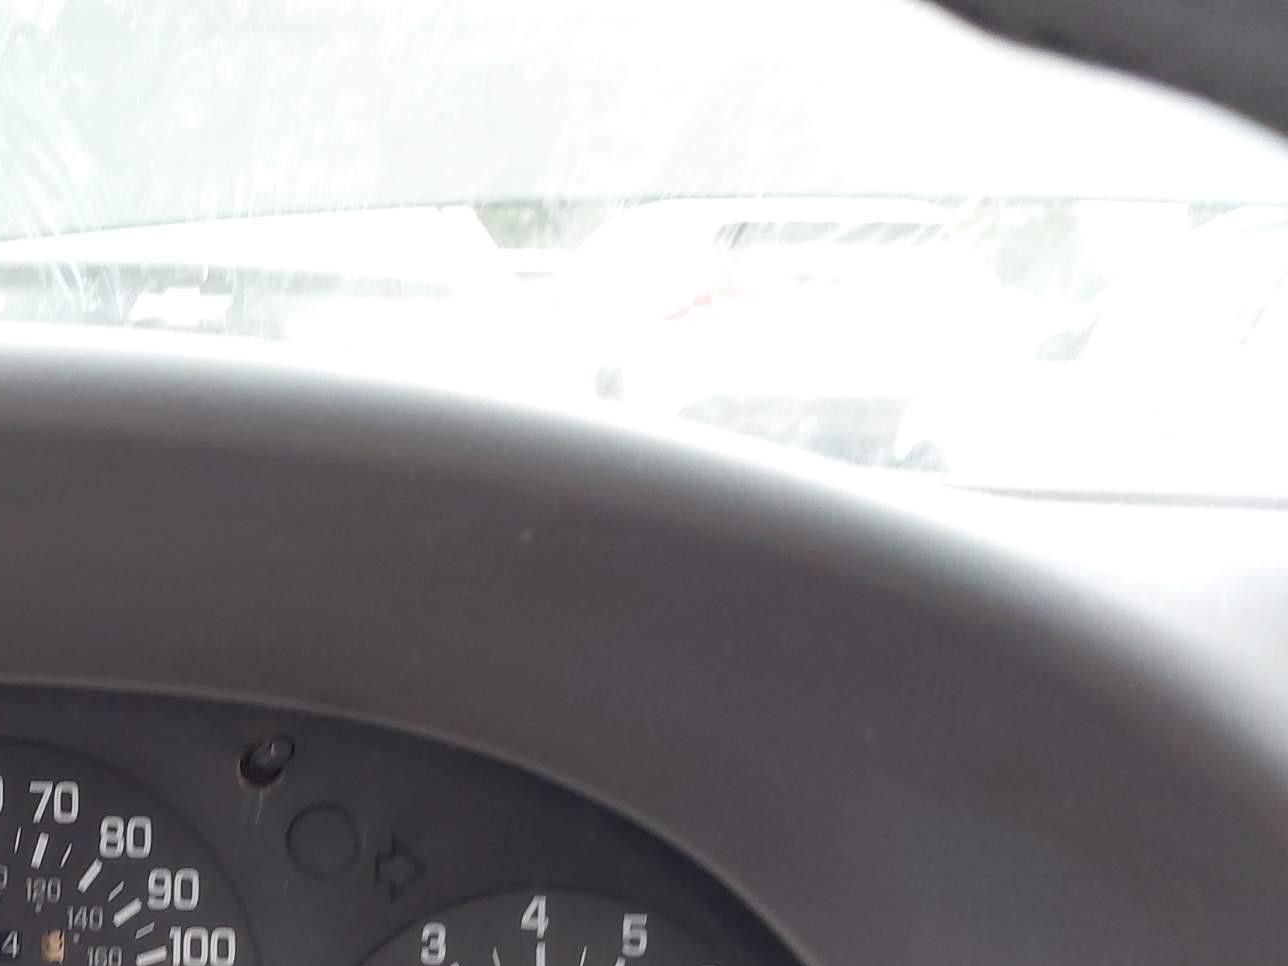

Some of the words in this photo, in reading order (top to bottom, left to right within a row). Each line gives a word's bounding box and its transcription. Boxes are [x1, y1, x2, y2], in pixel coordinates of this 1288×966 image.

[29, 780, 80, 824] 70
[99, 815, 152, 859] 80
[25, 876, 61, 903] 120
[147, 867, 200, 911] 90
[67, 905, 104, 931] 140
[520, 895, 549, 940] 4
[622, 914, 648, 957] 5
[420, 922, 447, 966] 3
